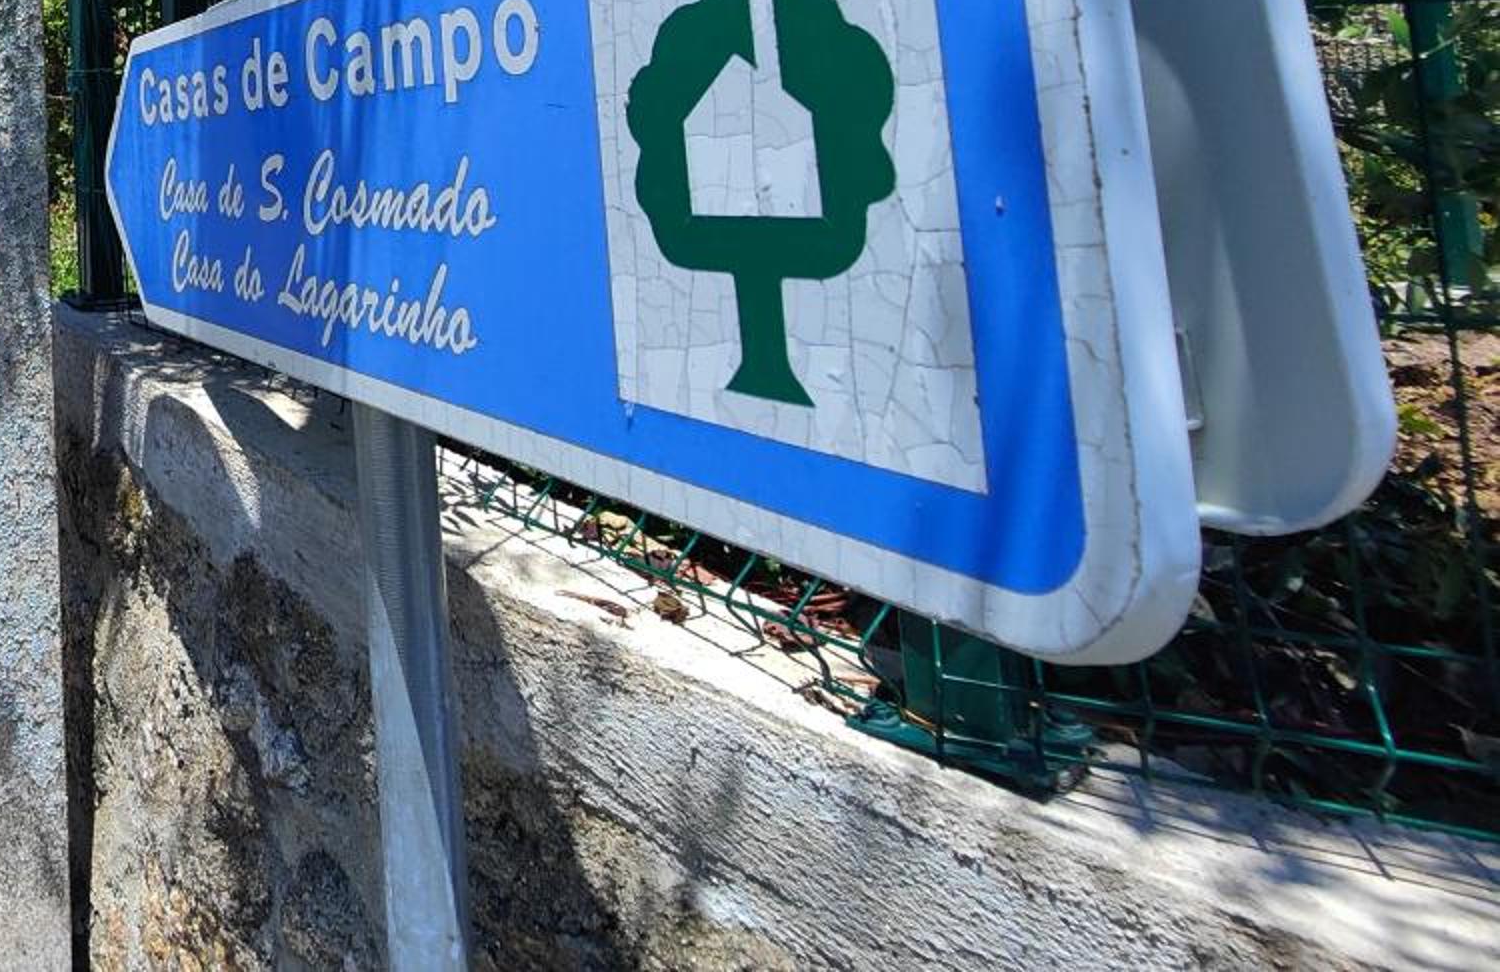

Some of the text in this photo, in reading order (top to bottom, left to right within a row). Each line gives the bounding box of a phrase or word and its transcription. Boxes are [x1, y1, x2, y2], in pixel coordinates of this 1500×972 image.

[140, 65, 228, 126] Casas
[241, 37, 288, 110] de
[159, 148, 497, 237] Casa de S. Cosmado
[171, 229, 478, 354] Casa do Lagarinho
